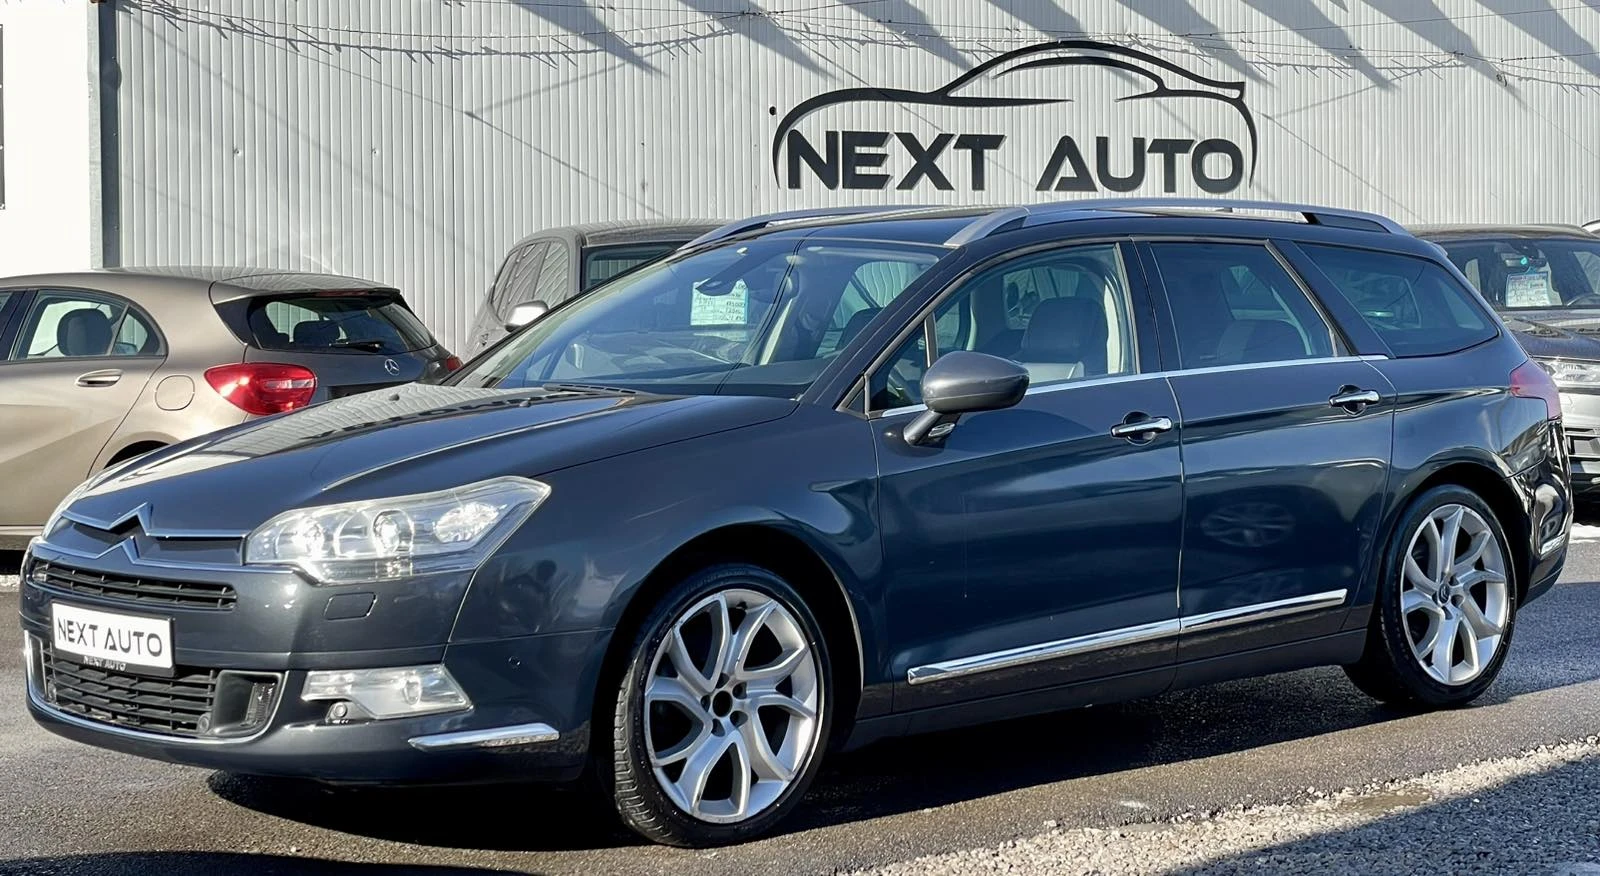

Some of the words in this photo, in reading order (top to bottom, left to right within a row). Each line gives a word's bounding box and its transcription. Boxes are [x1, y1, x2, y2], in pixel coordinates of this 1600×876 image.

[787, 129, 1006, 191] NEXT
[1035, 135, 1244, 194] AUTO
[58, 617, 98, 648] NEXT
[104, 627, 163, 657] AUTO
[83, 655, 103, 667] NEXT
[104, 659, 127, 671] AUTO
